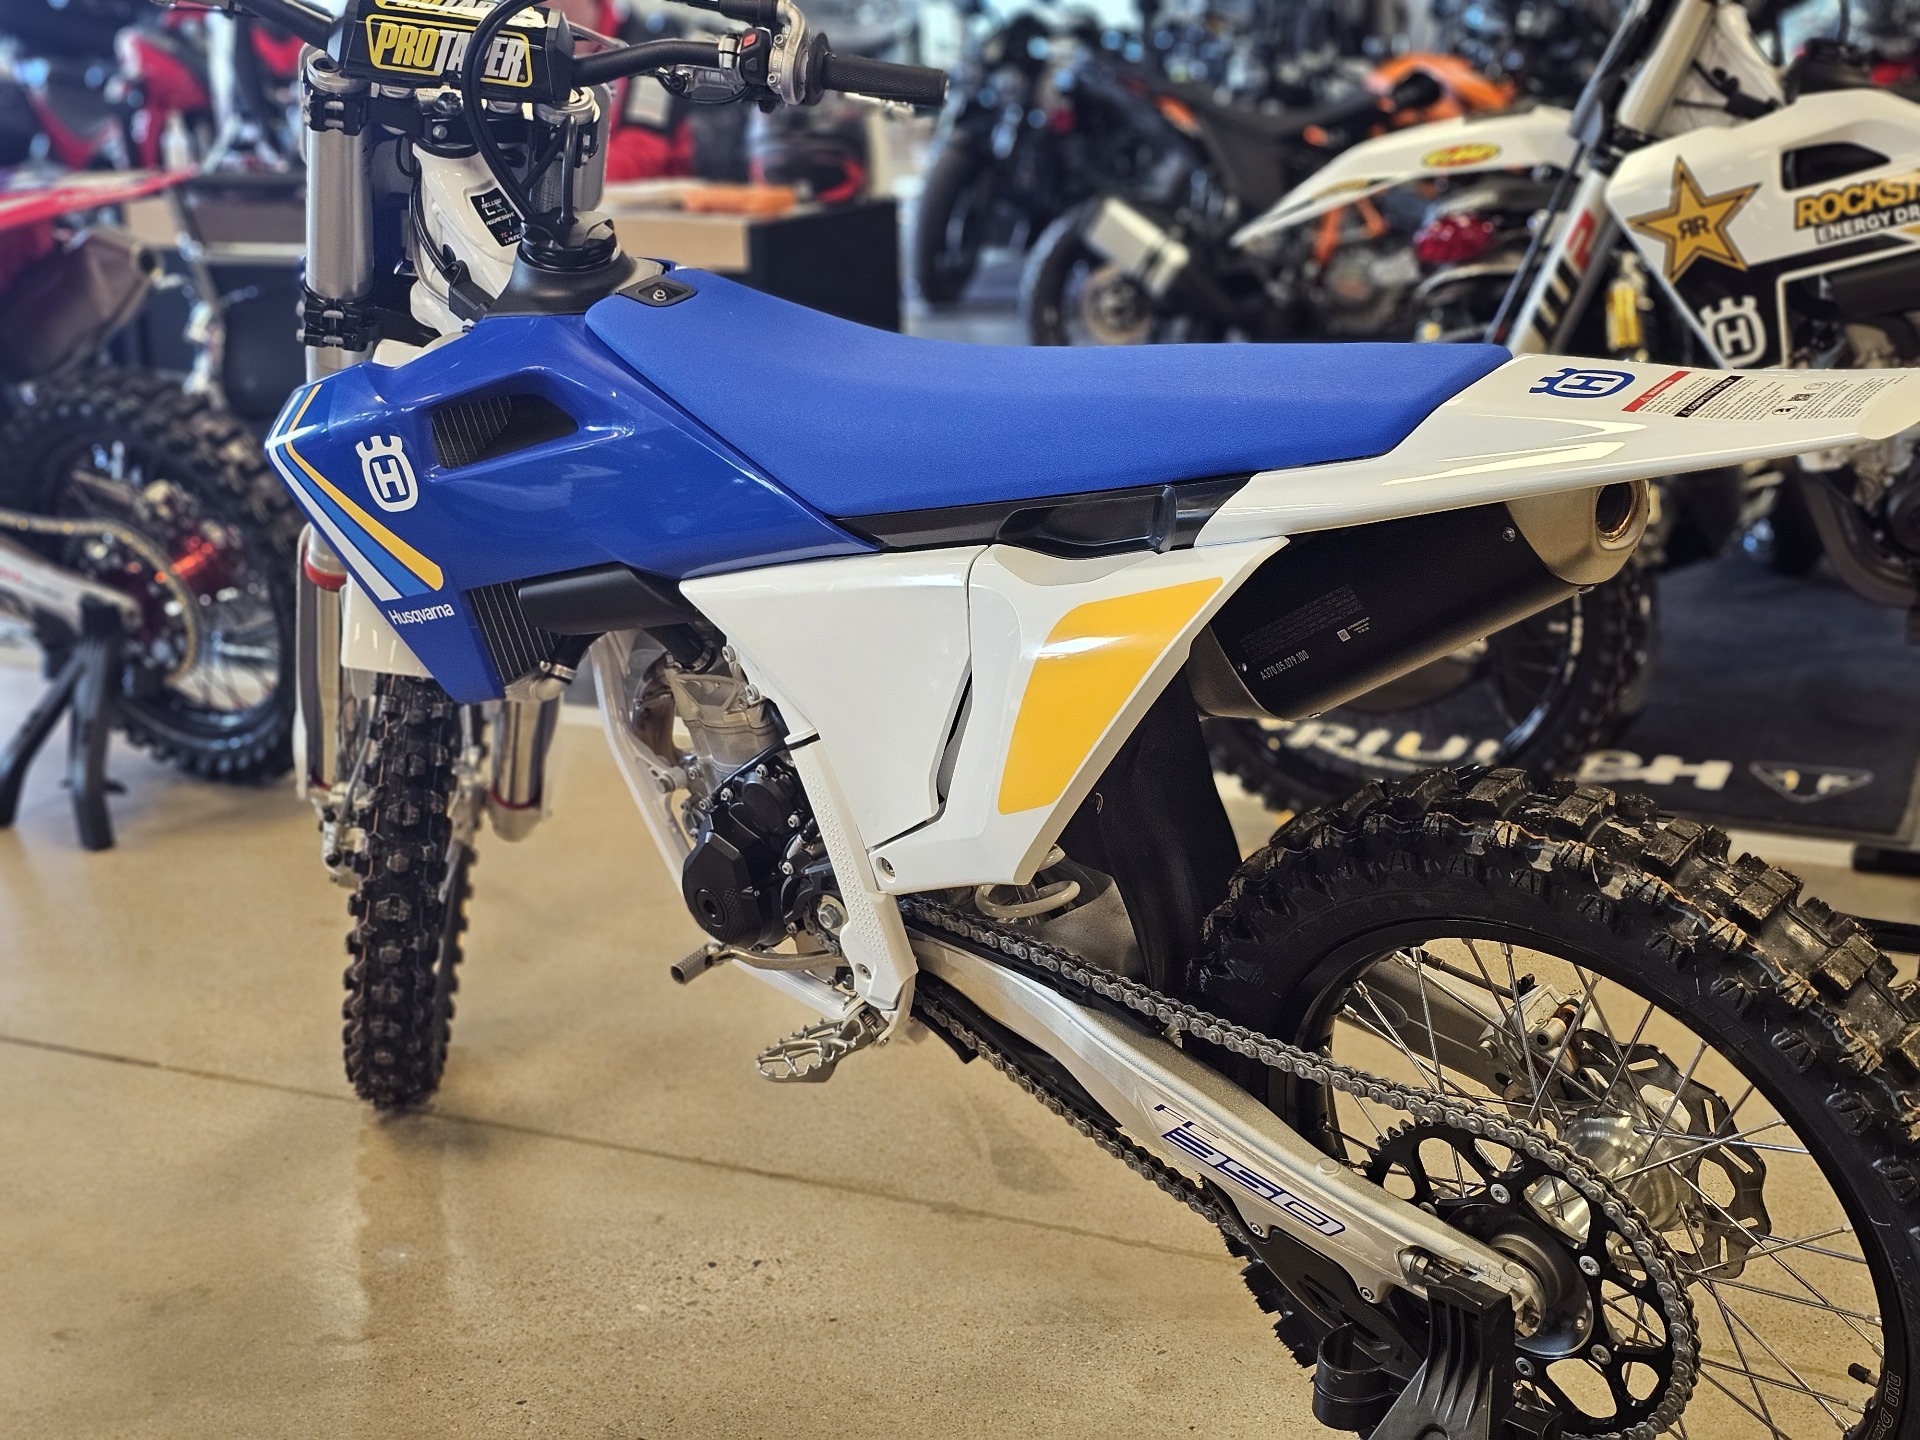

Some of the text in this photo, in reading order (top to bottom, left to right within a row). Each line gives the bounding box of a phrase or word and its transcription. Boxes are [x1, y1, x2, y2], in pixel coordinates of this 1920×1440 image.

[374, 21, 526, 82] PROTAER
[1816, 210, 1891, 244] ENERGY
[388, 603, 455, 626] Husqvarna
[1161, 1126, 1346, 1237] 350
